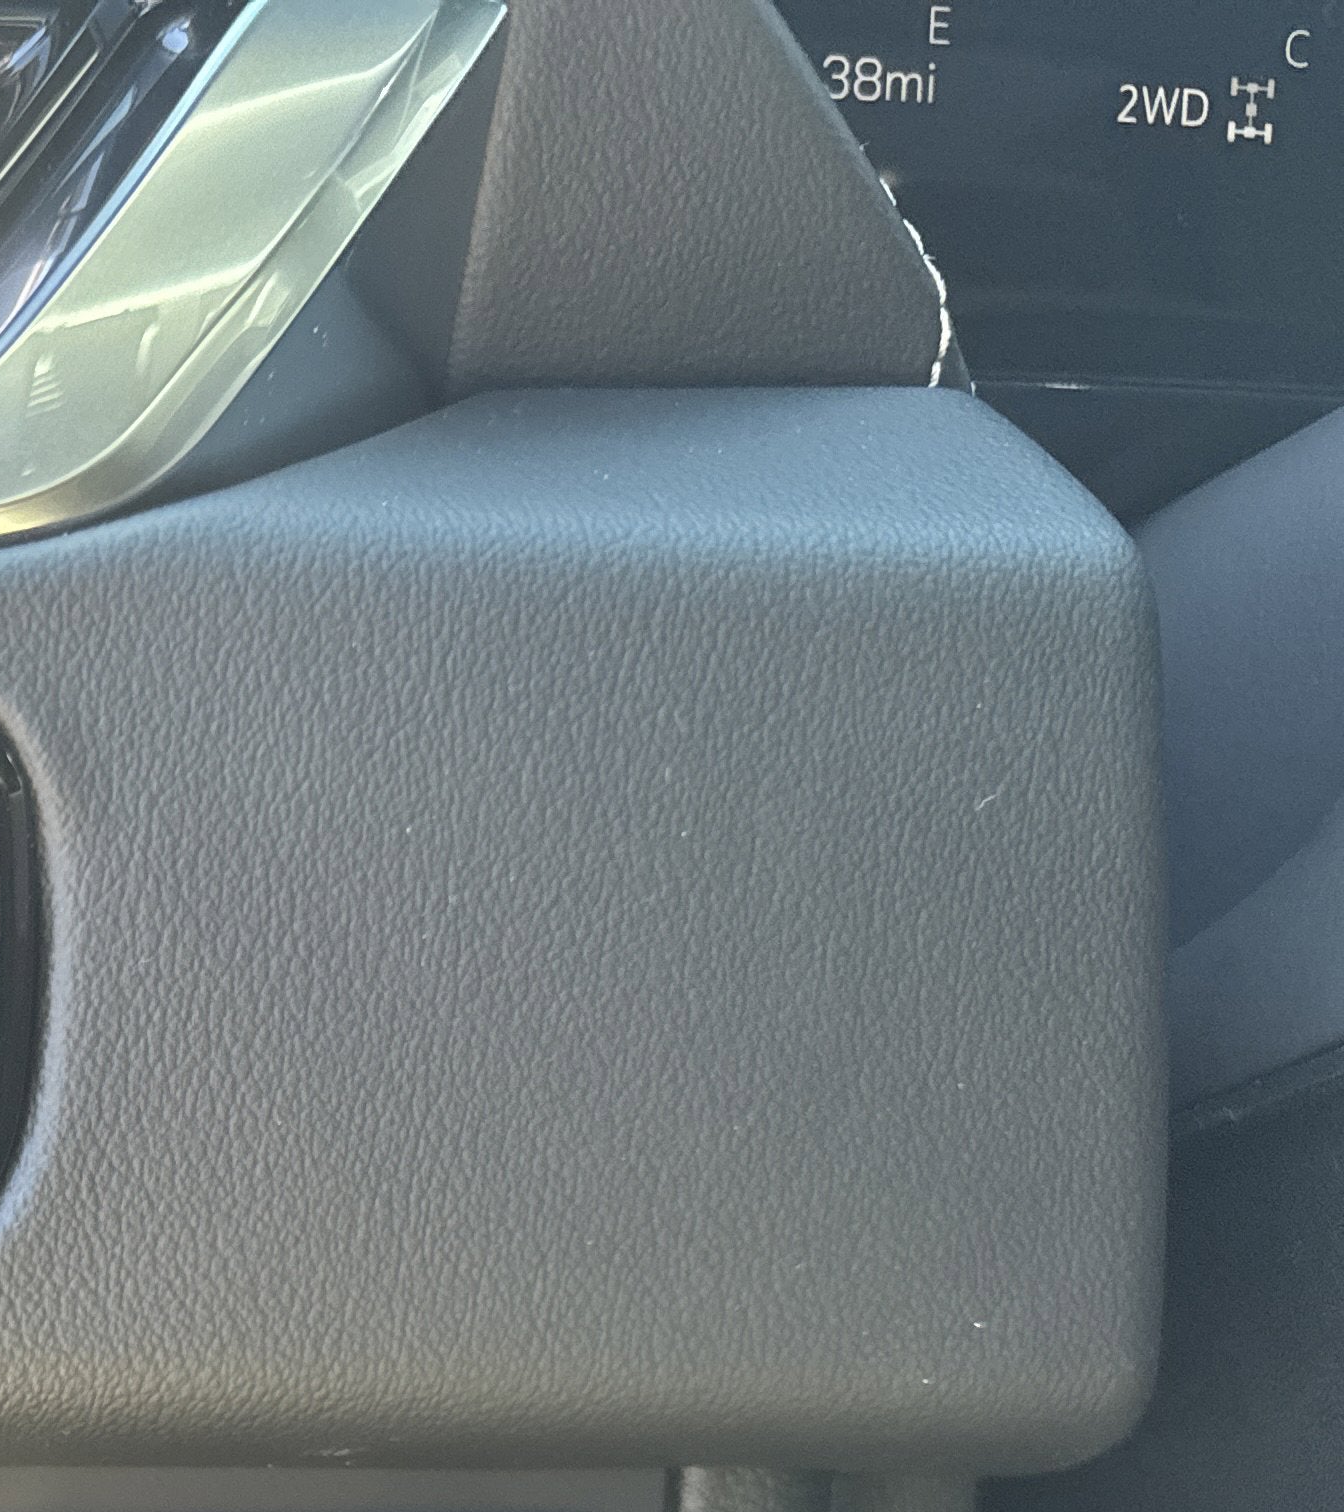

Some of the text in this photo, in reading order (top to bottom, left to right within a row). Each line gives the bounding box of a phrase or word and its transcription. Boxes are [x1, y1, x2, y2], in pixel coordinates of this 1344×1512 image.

[928, 5, 952, 46] E
[1284, 29, 1311, 69] C
[1116, 83, 1210, 127] 2WD
